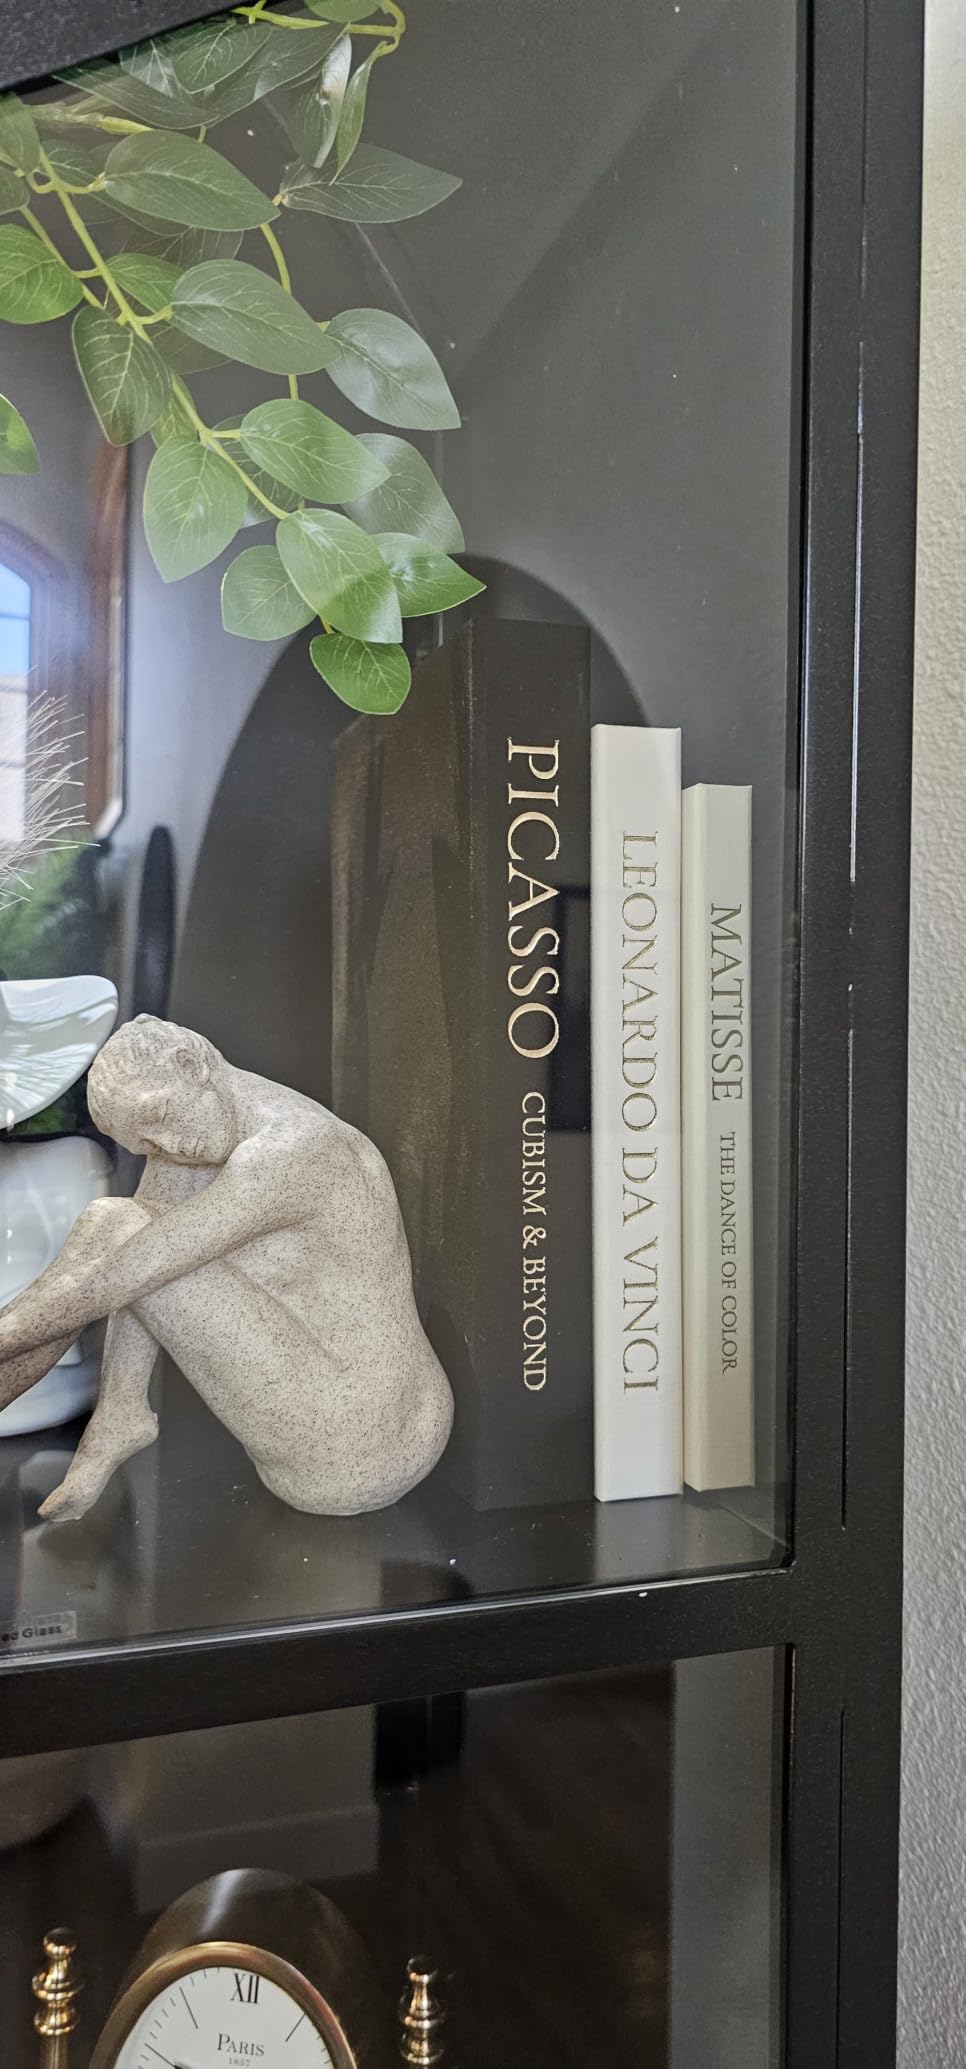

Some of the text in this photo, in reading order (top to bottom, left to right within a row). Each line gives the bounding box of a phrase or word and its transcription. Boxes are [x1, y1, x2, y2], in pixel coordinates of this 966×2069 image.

[507, 737, 560, 1391] PICASSO CUBISM & BEYOND
[622, 831, 660, 1394] LEONARDO DA VINCI
[711, 903, 745, 1374] MATISSE THE DANCE OF COLOR
[22, 1625, 62, 1638] Glass
[230, 1972, 260, 2004] XII
